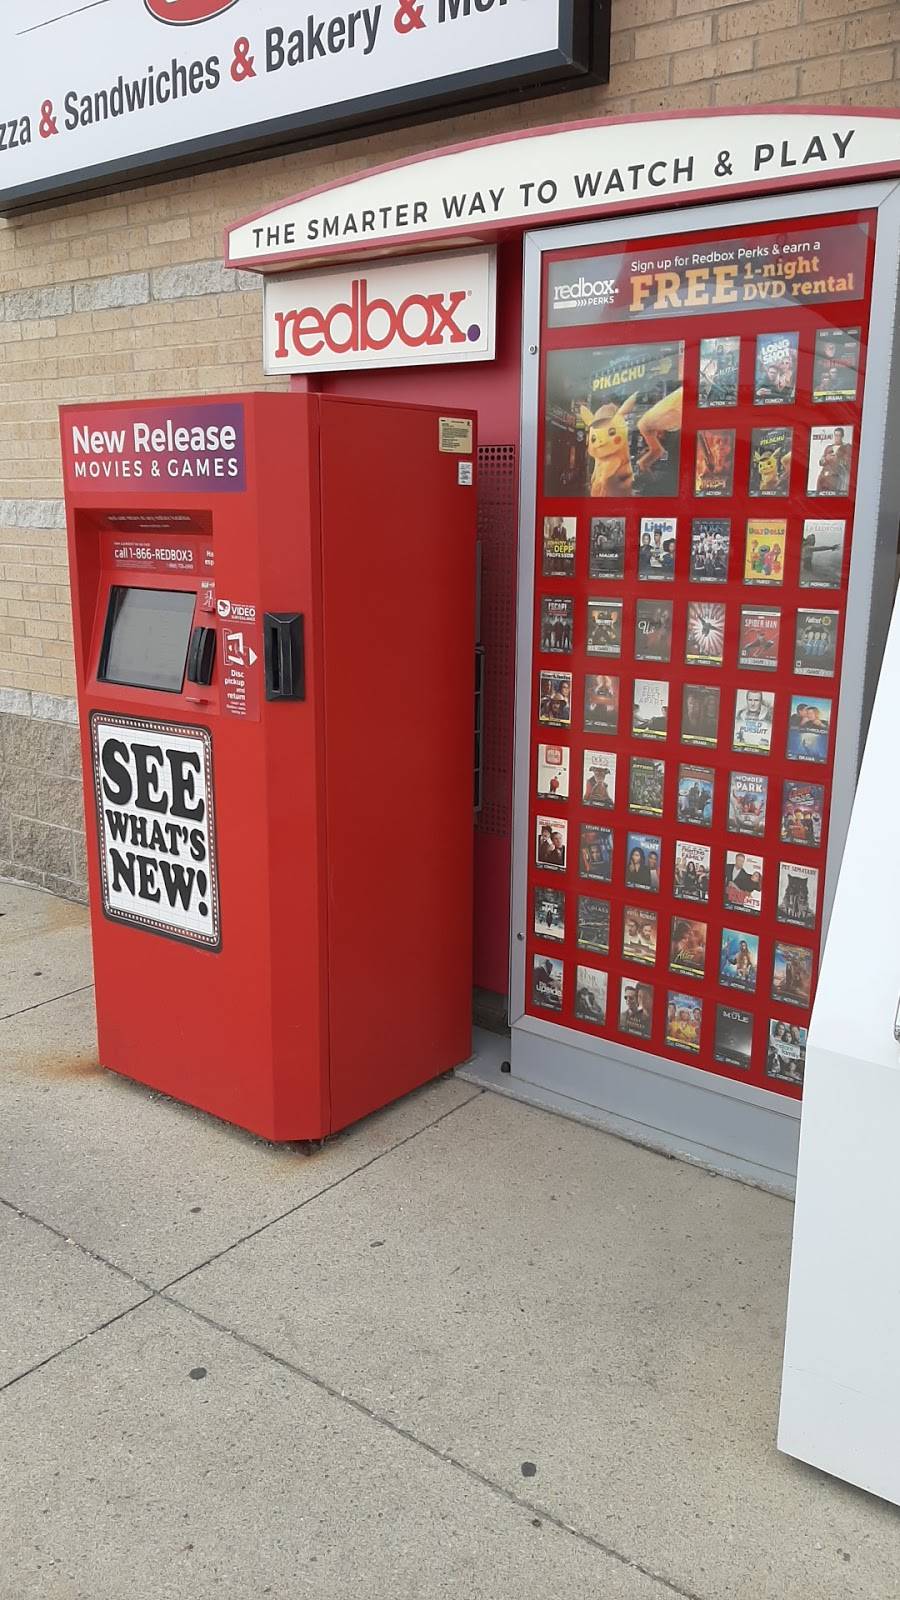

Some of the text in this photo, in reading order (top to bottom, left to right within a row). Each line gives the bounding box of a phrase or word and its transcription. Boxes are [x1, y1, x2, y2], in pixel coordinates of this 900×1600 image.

[39, 99, 59, 138] &
[64, 55, 220, 131] Sandwiches
[230, 36, 256, 82] &
[265, 4, 382, 73] Bakery
[394, 0, 426, 34] &
[252, 130, 856, 249] THE SMARTER WAY TO WATCH & PLAY
[631, 240, 821, 273] Sign up for Redbox Perks & earn a
[743, 255, 820, 280] 1-night
[629, 264, 738, 312] FREE
[742, 272, 854, 301] DVD rental
[587, 296, 615, 306] PERKS
[761, 339, 790, 355] LONG
[592, 364, 646, 392] PIKACHU
[72, 419, 237, 455] New Release
[74, 457, 239, 477] MOVIES & GAMES
[644, 522, 673, 533] Little
[114, 547, 193, 562] call 1-866-REDBOX3
[554, 545, 575, 553] DEPP
[231, 606, 256, 617] VIDEO
[224, 678, 245, 687] pickup
[231, 669, 244, 678] Disc
[227, 692, 246, 701] return
[102, 737, 205, 822] SEE
[736, 781, 763, 792] PARK
[104, 809, 206, 862] WHAT'S
[108, 848, 208, 917] NEW!
[722, 1010, 750, 1024] MULE
